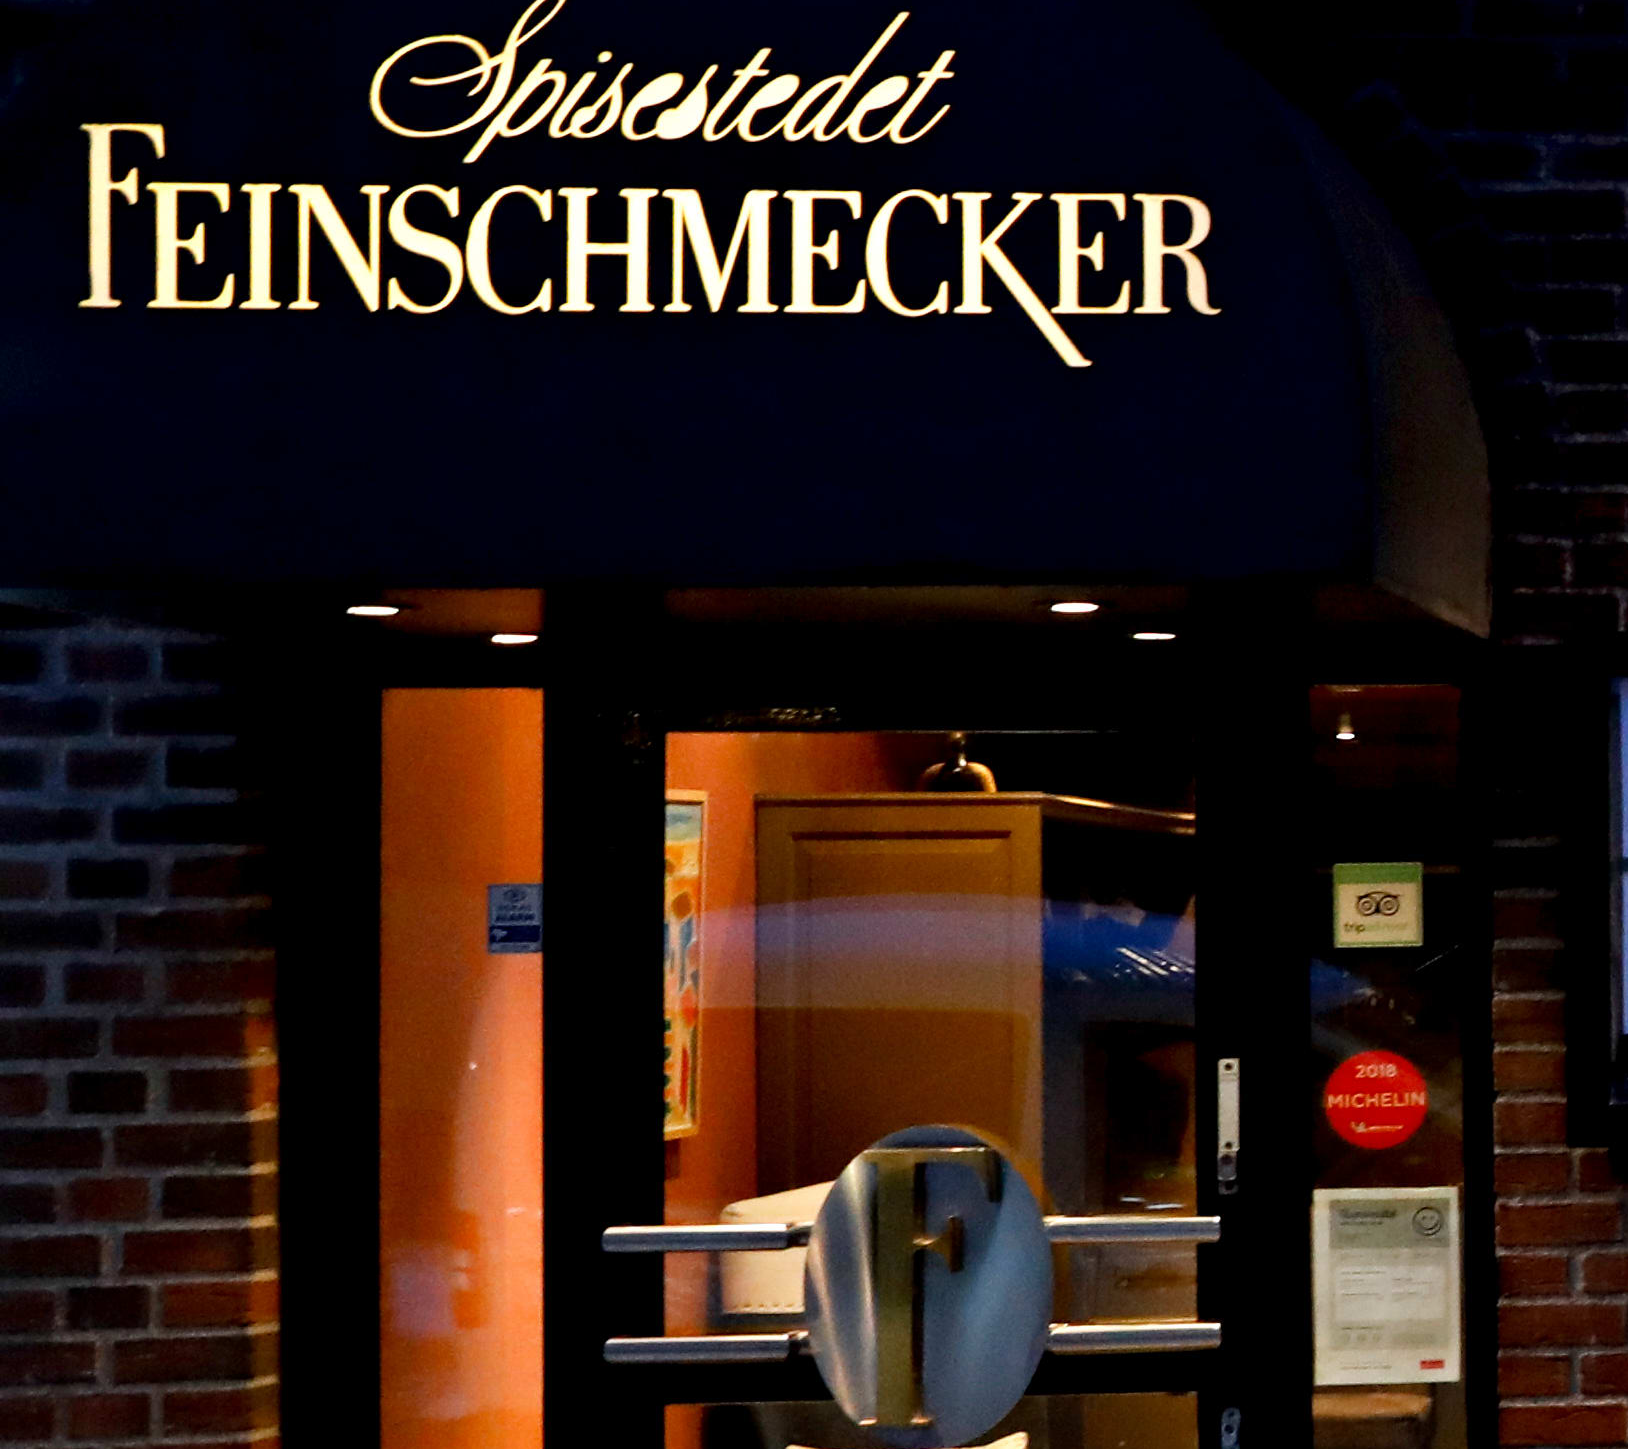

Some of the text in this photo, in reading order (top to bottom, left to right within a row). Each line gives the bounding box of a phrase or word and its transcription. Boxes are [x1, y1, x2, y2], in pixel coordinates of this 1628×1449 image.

[77, 122, 1222, 368] FEINSCHMECKER
[1326, 1090, 1426, 1109] MICHELIN
[1355, 1062, 1398, 1079] 2018
[858, 1145, 1004, 1429] F
